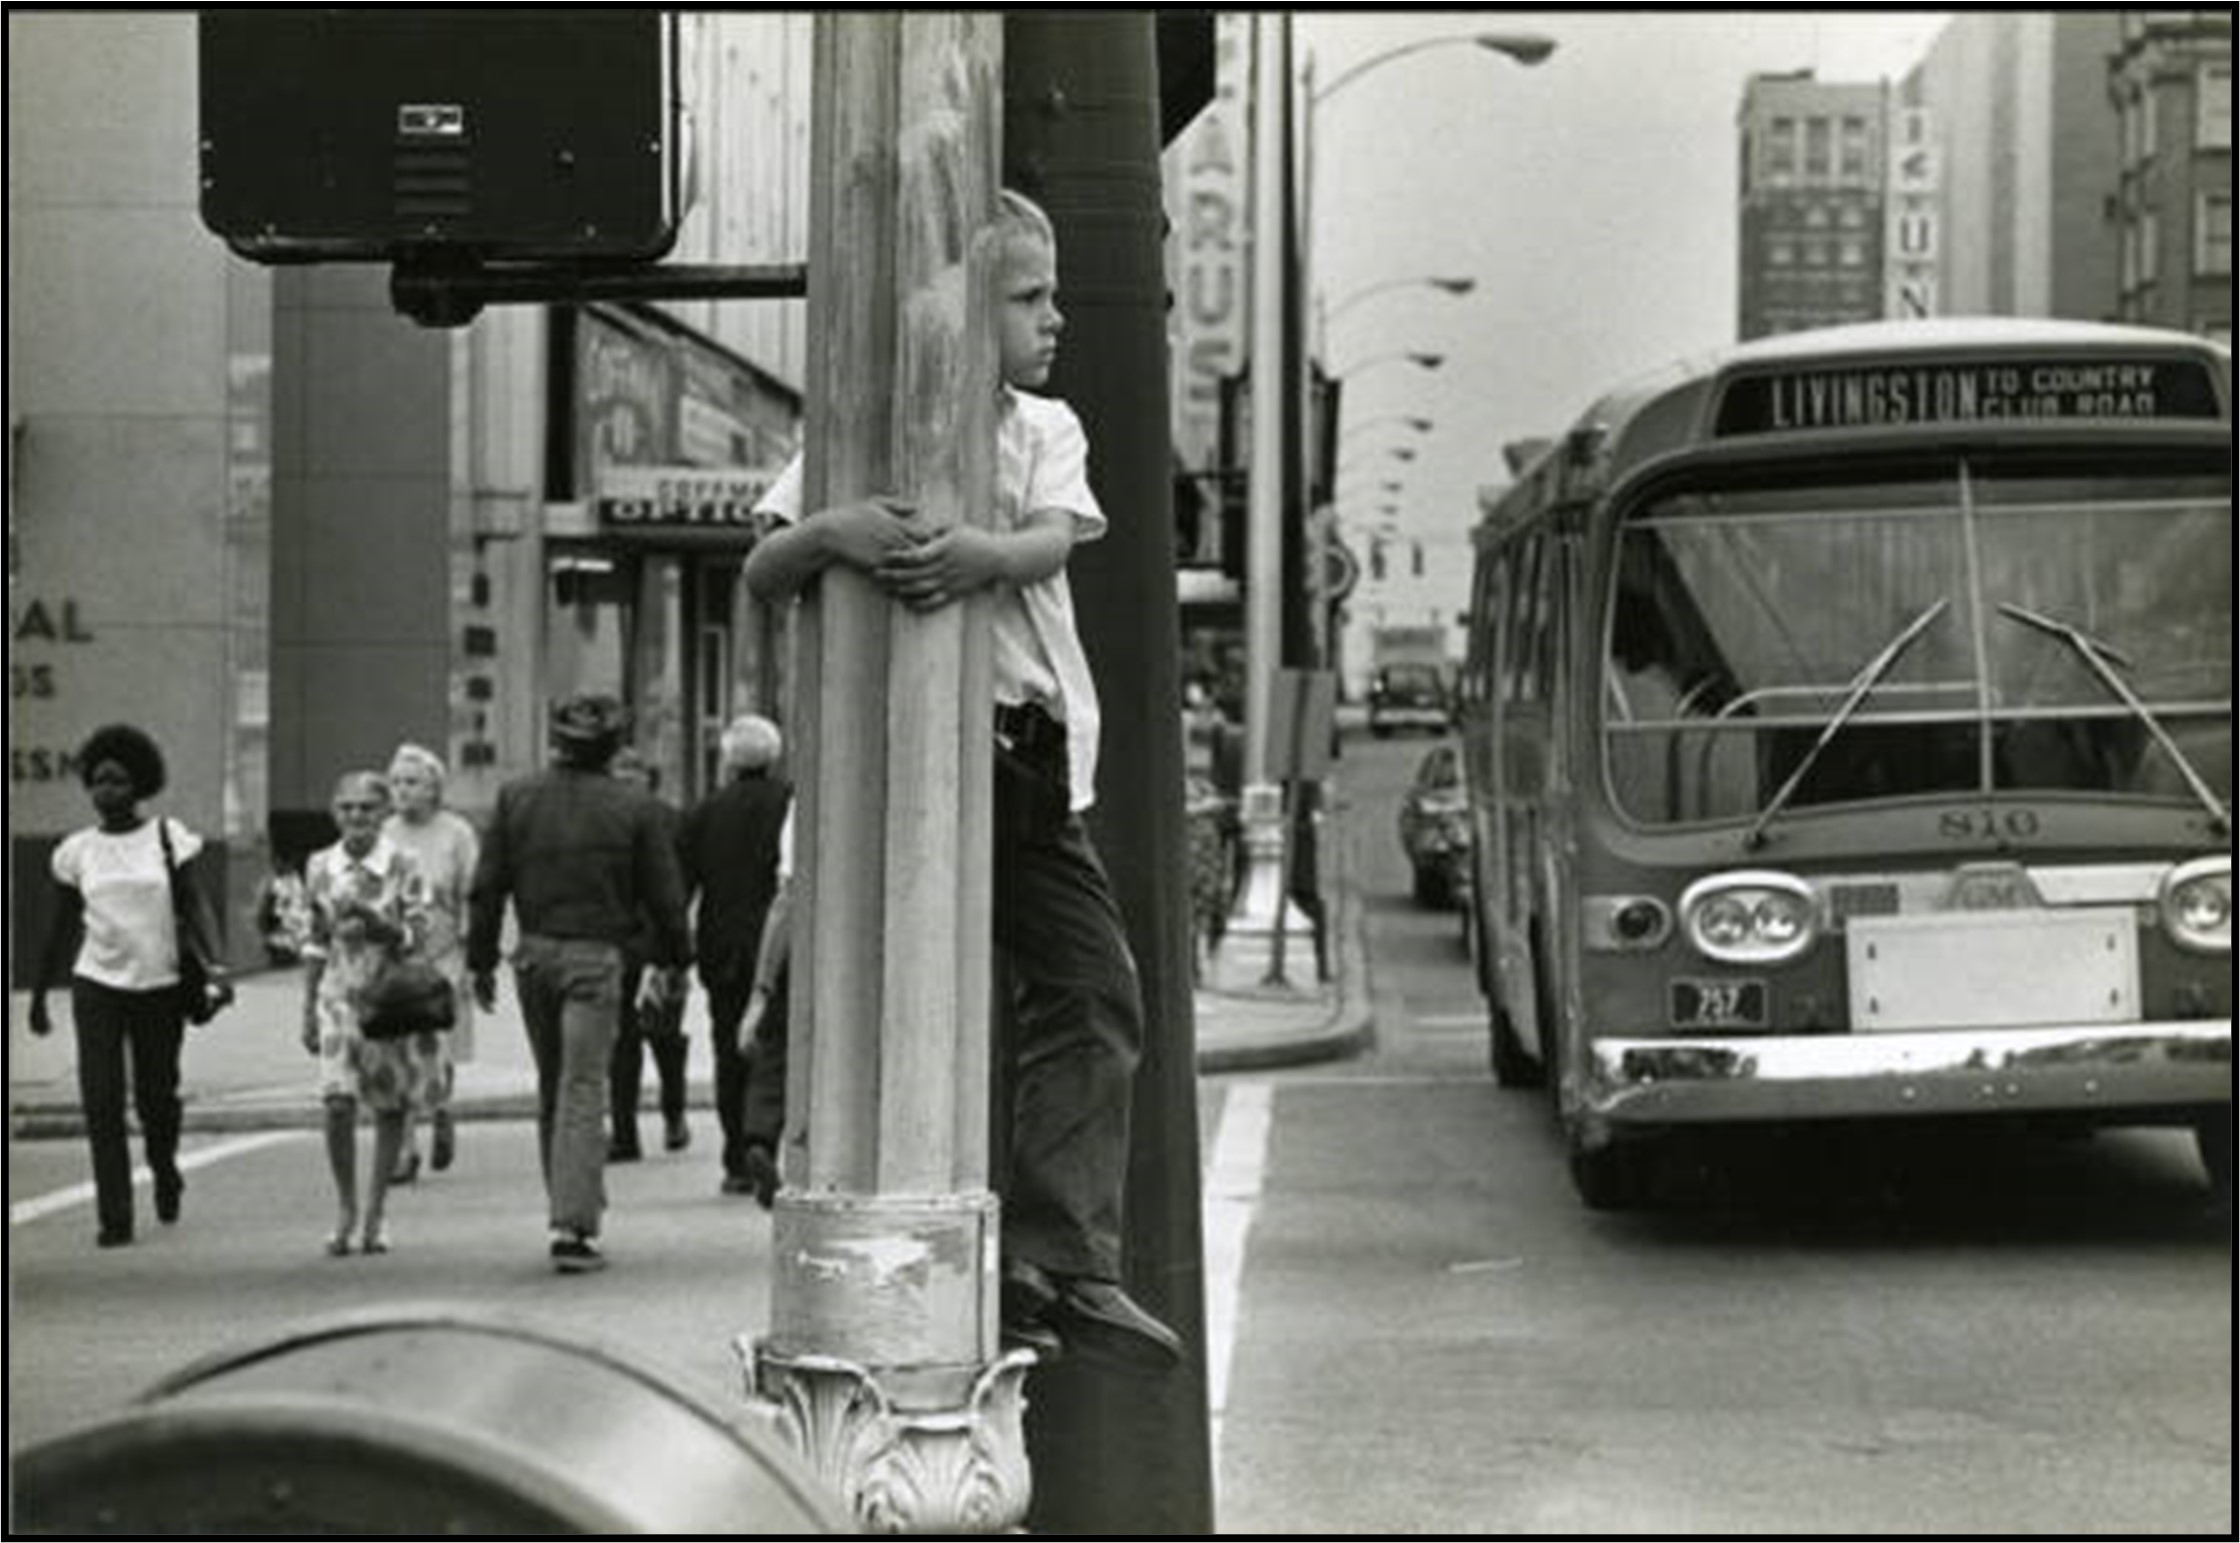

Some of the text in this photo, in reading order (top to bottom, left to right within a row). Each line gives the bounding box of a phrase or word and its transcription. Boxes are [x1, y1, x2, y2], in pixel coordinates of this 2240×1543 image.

[1772, 369, 1976, 427] LIVINGSTON
[1983, 365, 2155, 393] TO COUNTRY
